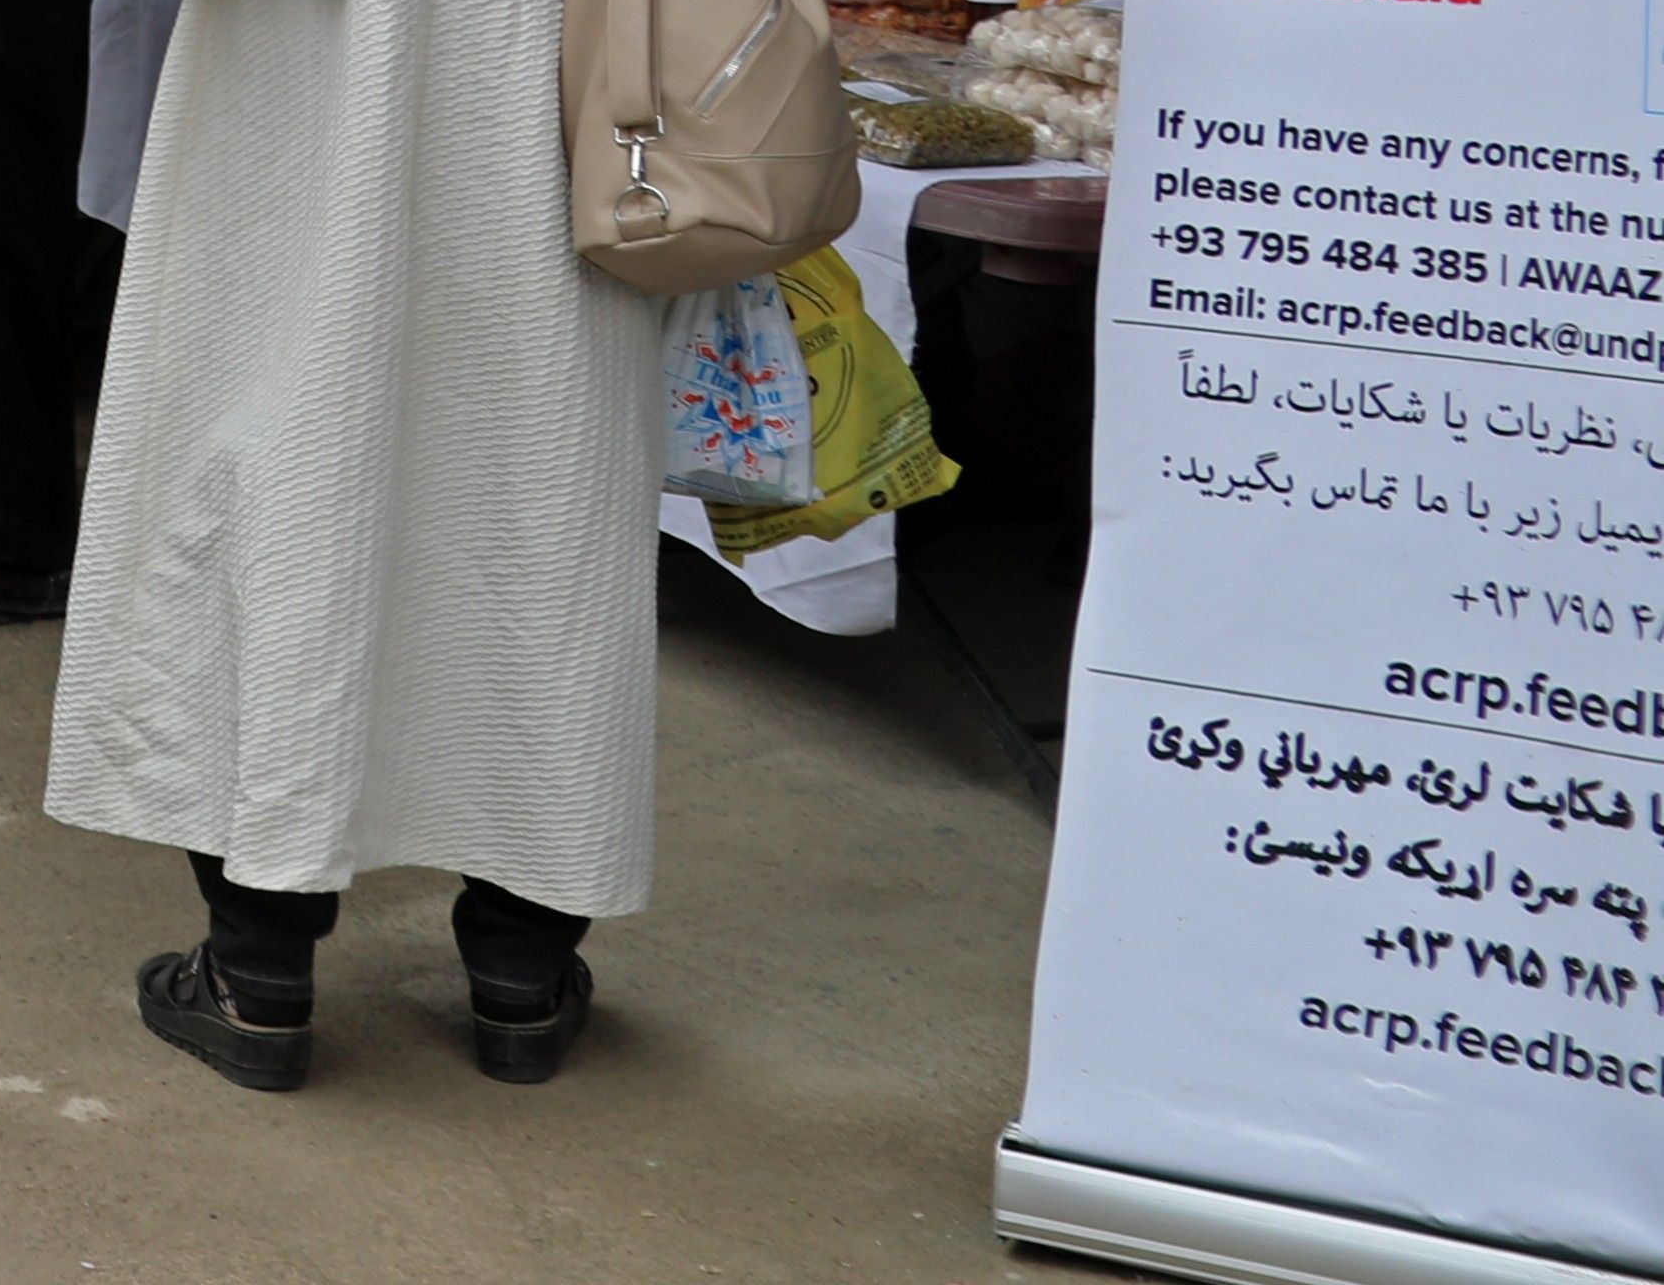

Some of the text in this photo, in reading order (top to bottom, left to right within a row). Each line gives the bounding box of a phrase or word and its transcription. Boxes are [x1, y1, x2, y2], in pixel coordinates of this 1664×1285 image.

[1157, 108, 1641, 184] If you have any concerns,
[1153, 167, 1438, 221] please contact
[1151, 223, 1663, 303] +93 795 484 385 AWAAZ
